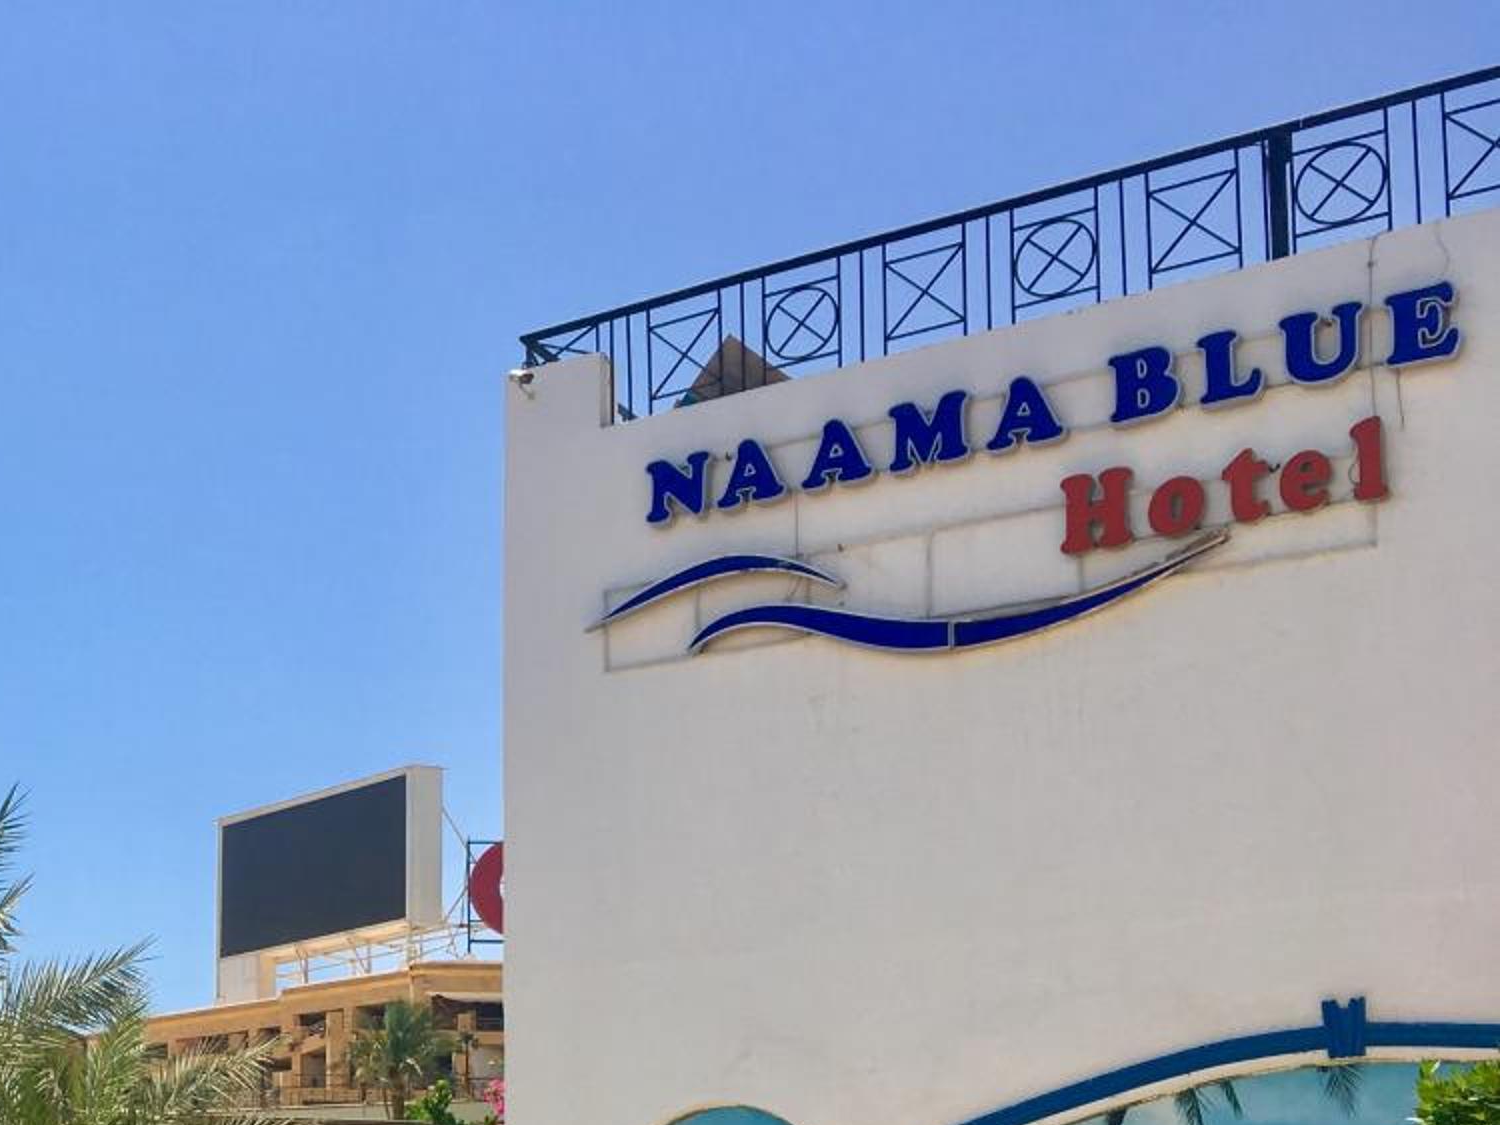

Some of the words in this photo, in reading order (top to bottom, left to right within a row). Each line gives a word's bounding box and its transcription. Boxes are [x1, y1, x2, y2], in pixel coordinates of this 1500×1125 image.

[646, 376, 1064, 525] NAAMA
[1109, 280, 1461, 424] BLUE
[1060, 416, 1390, 555] Hotel
